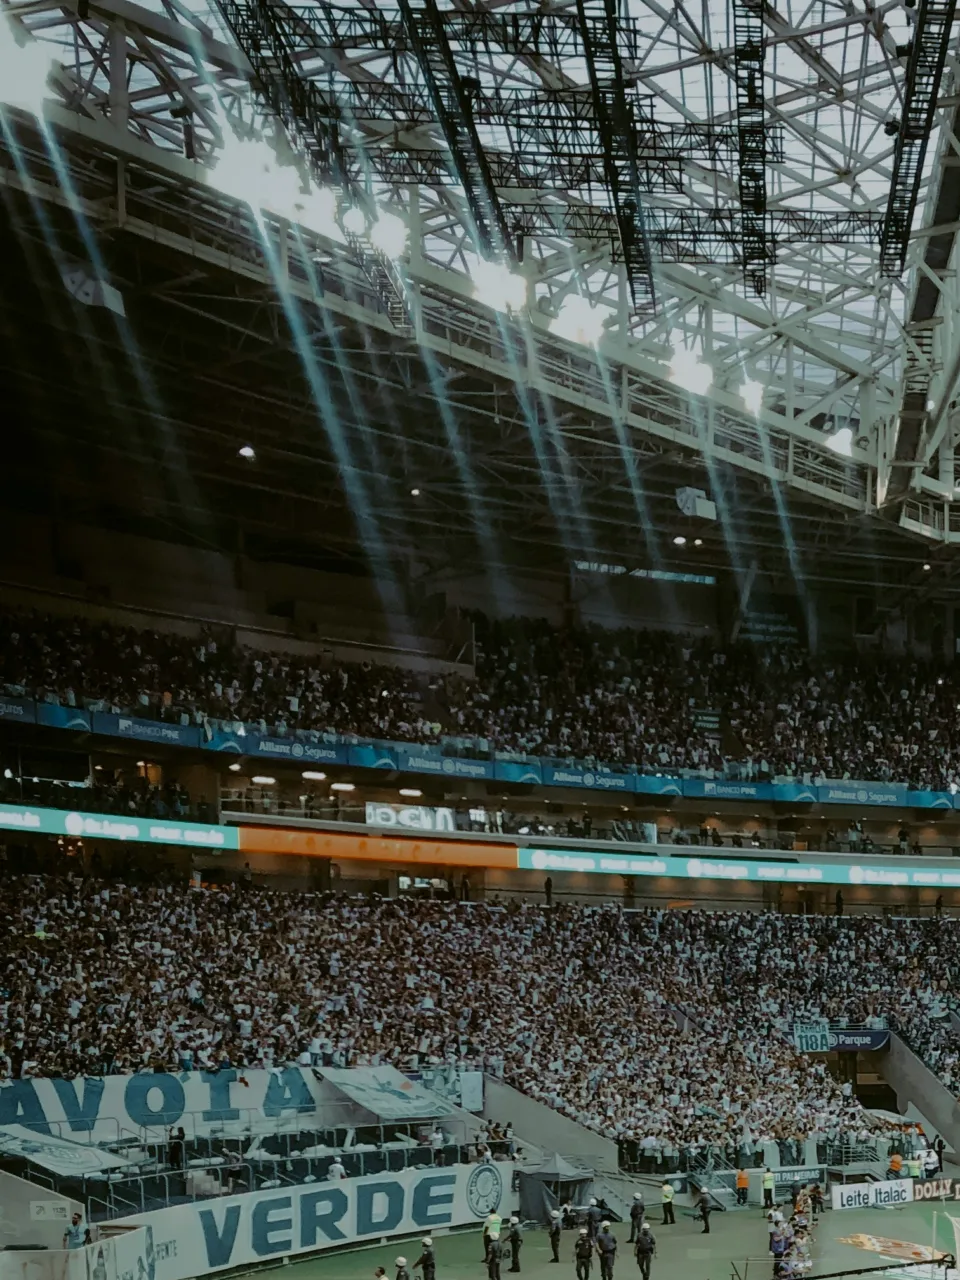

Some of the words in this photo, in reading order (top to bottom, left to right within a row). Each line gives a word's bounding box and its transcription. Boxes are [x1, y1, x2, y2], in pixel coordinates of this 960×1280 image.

[0, 703, 24, 715] guros
[259, 741, 291, 754] Allianz
[304, 746, 337, 759] Seguros
[408, 757, 441, 770] Allianz
[456, 762, 486, 776] Parque
[553, 771, 583, 784] Allianz
[595, 775, 626, 788] Seguros
[741, 786, 757, 796] PINE
[828, 790, 857, 800] Allianz
[868, 792, 897, 803] Seguros
[838, 1035, 872, 1047] Parque
[782, 1170, 820, 1181] PALMEIRAS
[840, 1189, 869, 1207] Leite
[874, 1187, 907, 1205] Italac
[914, 1178, 953, 1200] DOLLY
[199, 1174, 457, 1267] VERDE
